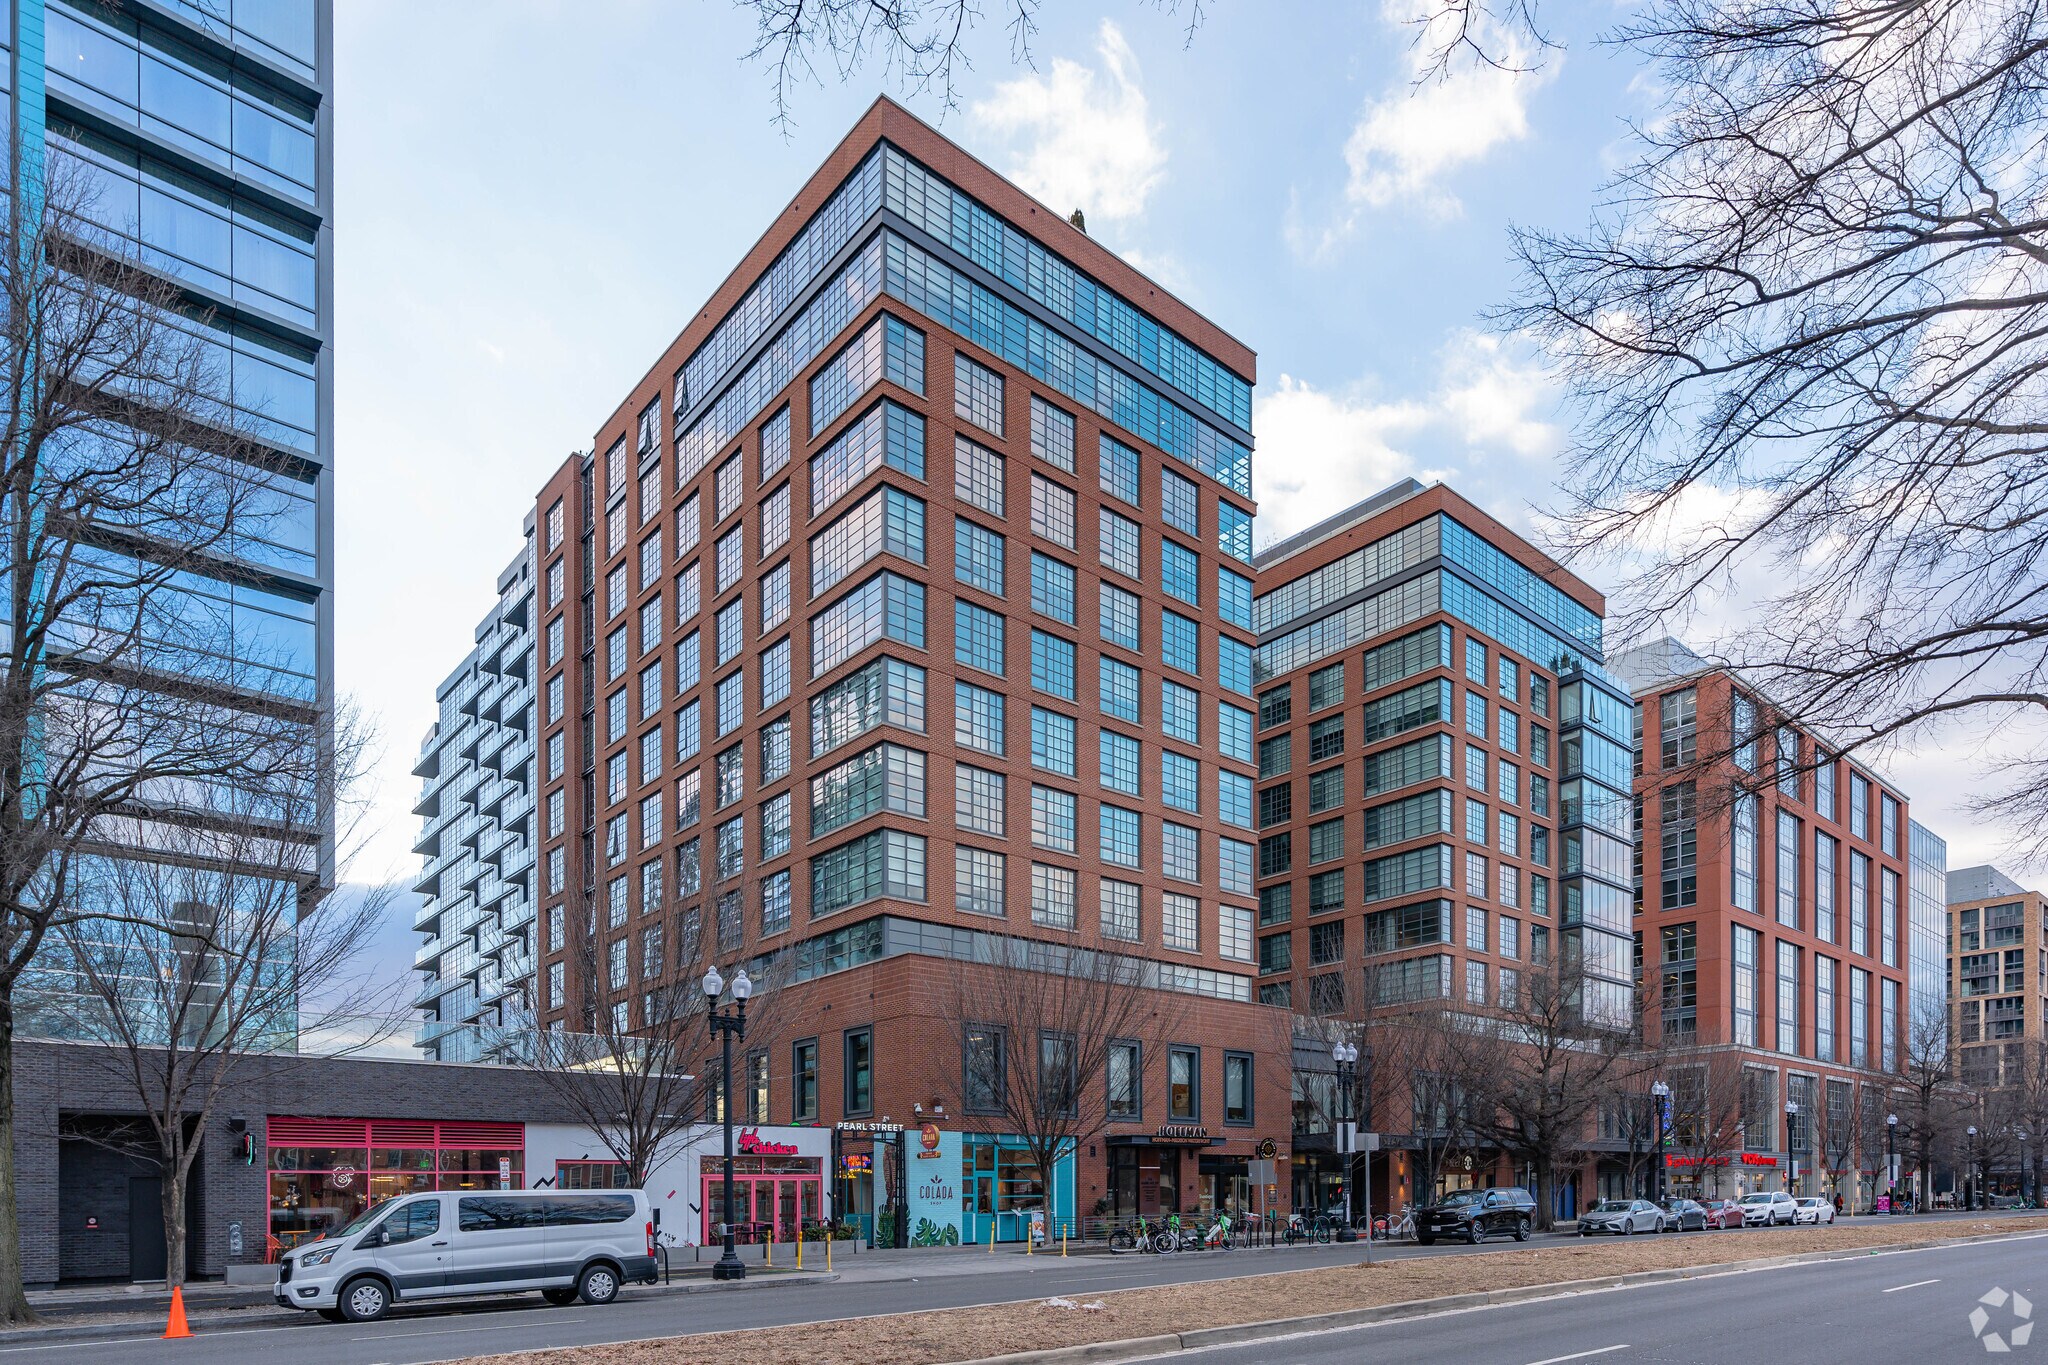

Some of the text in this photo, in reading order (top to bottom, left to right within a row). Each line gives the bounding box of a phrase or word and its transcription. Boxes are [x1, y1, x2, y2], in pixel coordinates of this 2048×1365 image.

[837, 1122, 904, 1132] PEARL STREET
[752, 1141, 799, 1155] chicken
[919, 1186, 953, 1199] COLADA
